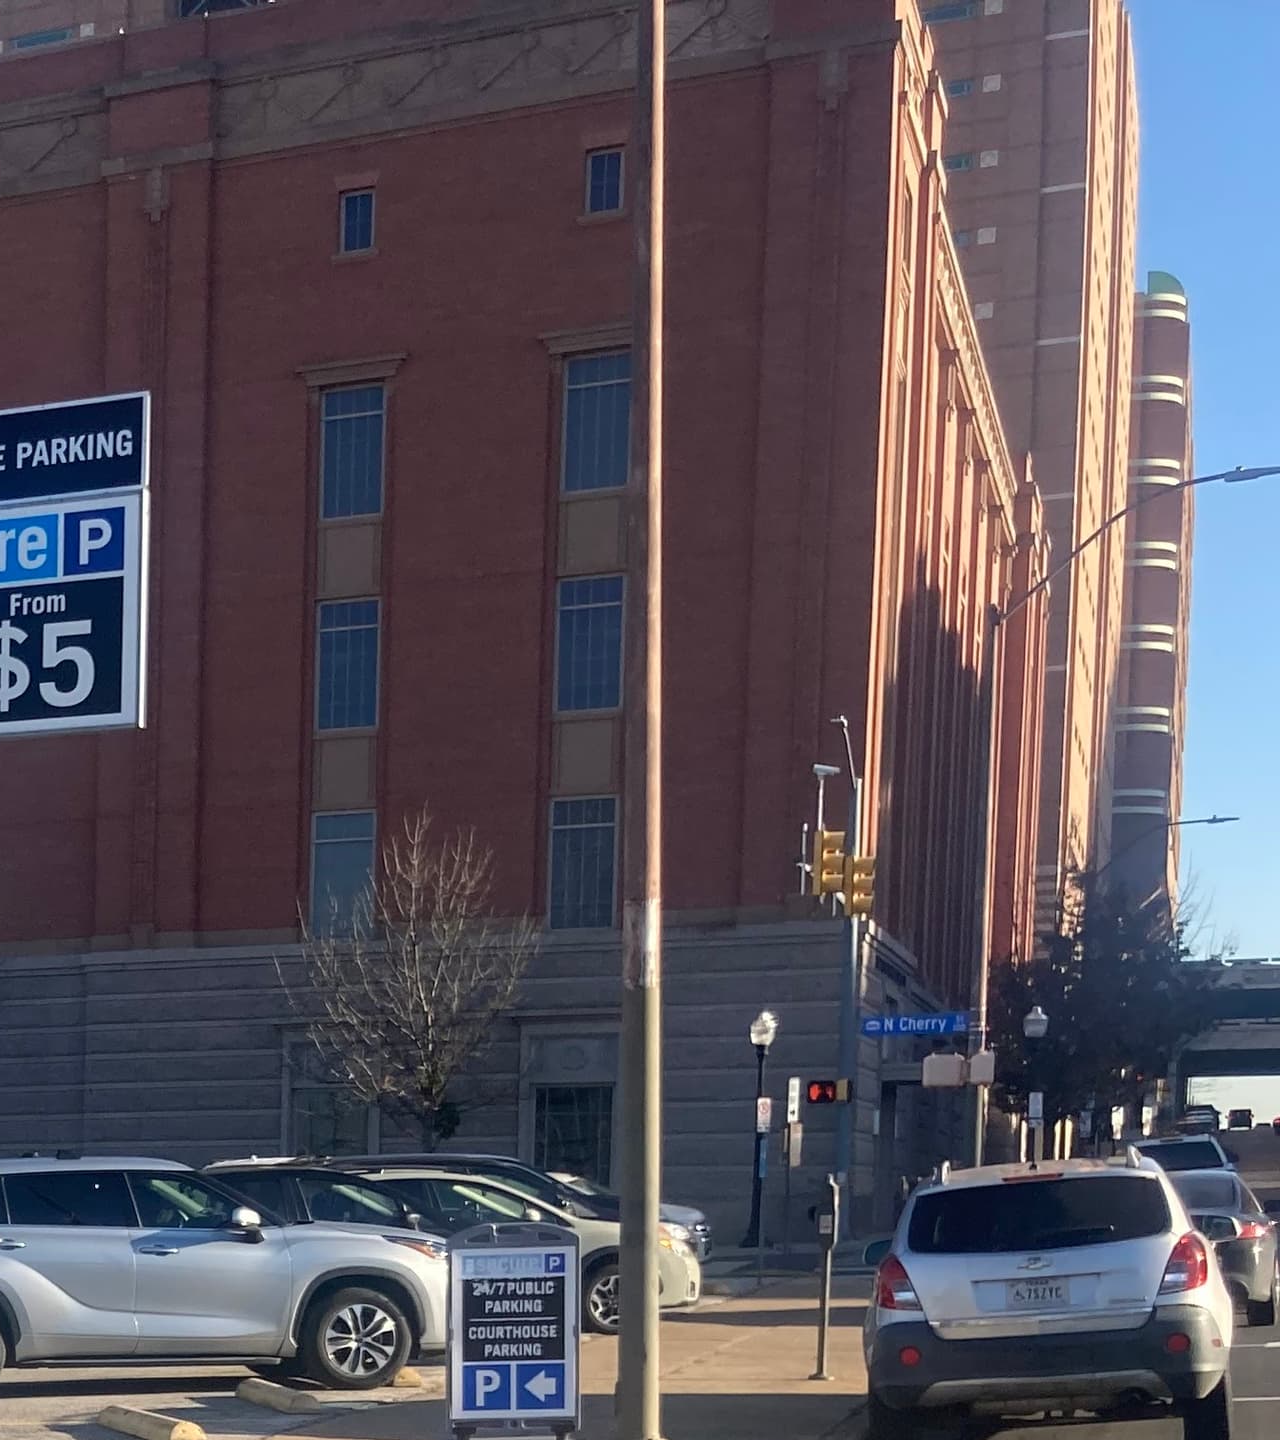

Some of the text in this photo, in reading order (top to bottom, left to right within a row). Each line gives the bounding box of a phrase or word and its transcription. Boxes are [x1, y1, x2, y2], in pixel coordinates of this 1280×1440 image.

[16, 429, 133, 468] PARKING
[79, 518, 113, 565] P
[9, 592, 66, 616] From
[884, 1017, 893, 1031] N
[900, 1016, 946, 1032] Cherry
[549, 1256, 561, 1271] P
[472, 1280, 554, 1296] 24/7 PUBLIC
[485, 1299, 542, 1313] PARKING
[468, 1325, 557, 1340] COURTHOUSE
[484, 1343, 542, 1357] PARKING
[475, 1369, 501, 1407] P
